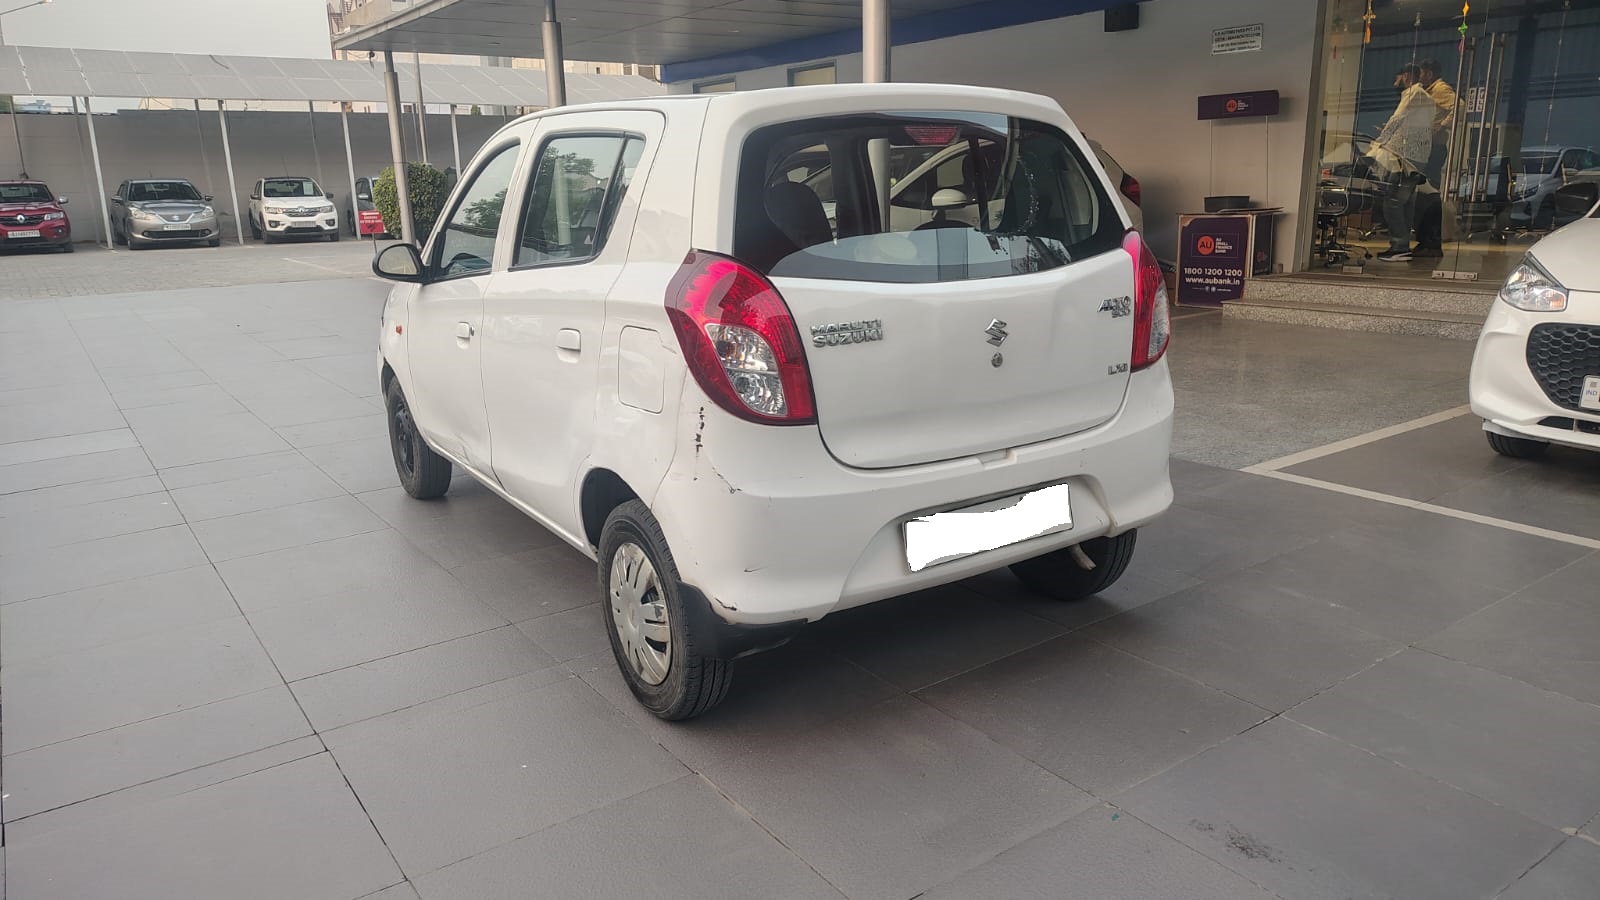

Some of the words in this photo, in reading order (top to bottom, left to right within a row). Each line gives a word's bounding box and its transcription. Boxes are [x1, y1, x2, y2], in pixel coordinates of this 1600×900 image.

[1199, 241, 1212, 249] AU
[1184, 267, 1203, 275] 1800
[1204, 268, 1223, 276] 1200
[1185, 277, 1240, 285] www.aubank.in
[810, 319, 882, 336] MARUTI
[812, 328, 883, 348] SUZUKI
